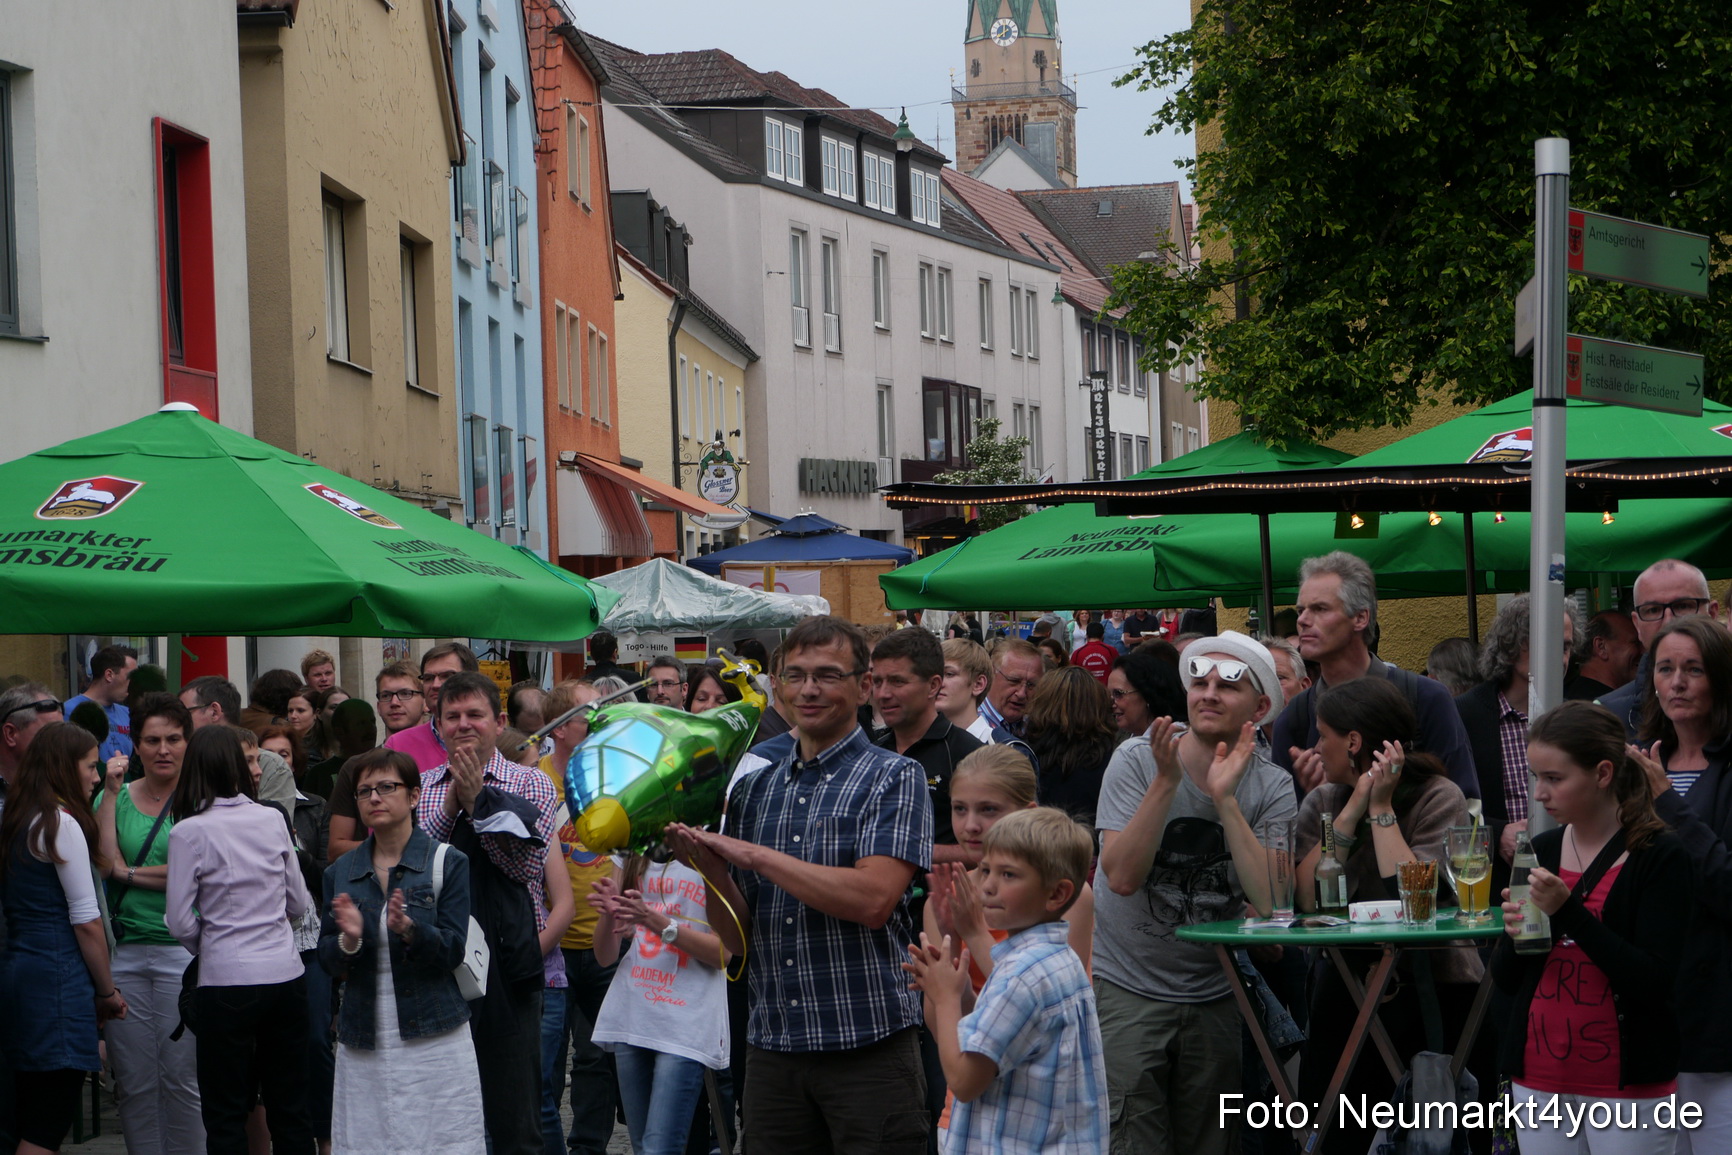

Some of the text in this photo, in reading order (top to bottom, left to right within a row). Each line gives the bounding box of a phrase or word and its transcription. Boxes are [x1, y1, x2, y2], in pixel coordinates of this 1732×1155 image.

[1588, 226, 1646, 250] Amtsgericht
[1586, 350, 1654, 374] Hist. Reitstadel
[1585, 373, 1680, 400] Festsäle der Residenz
[704, 477, 734, 493] Glossner
[800, 458, 878, 493] HACKNER
[50, 507, 87, 517] 1628
[625, 643, 645, 652] Togo
[1325, 823, 1334, 851] BLOND
[648, 877, 674, 894] AND
